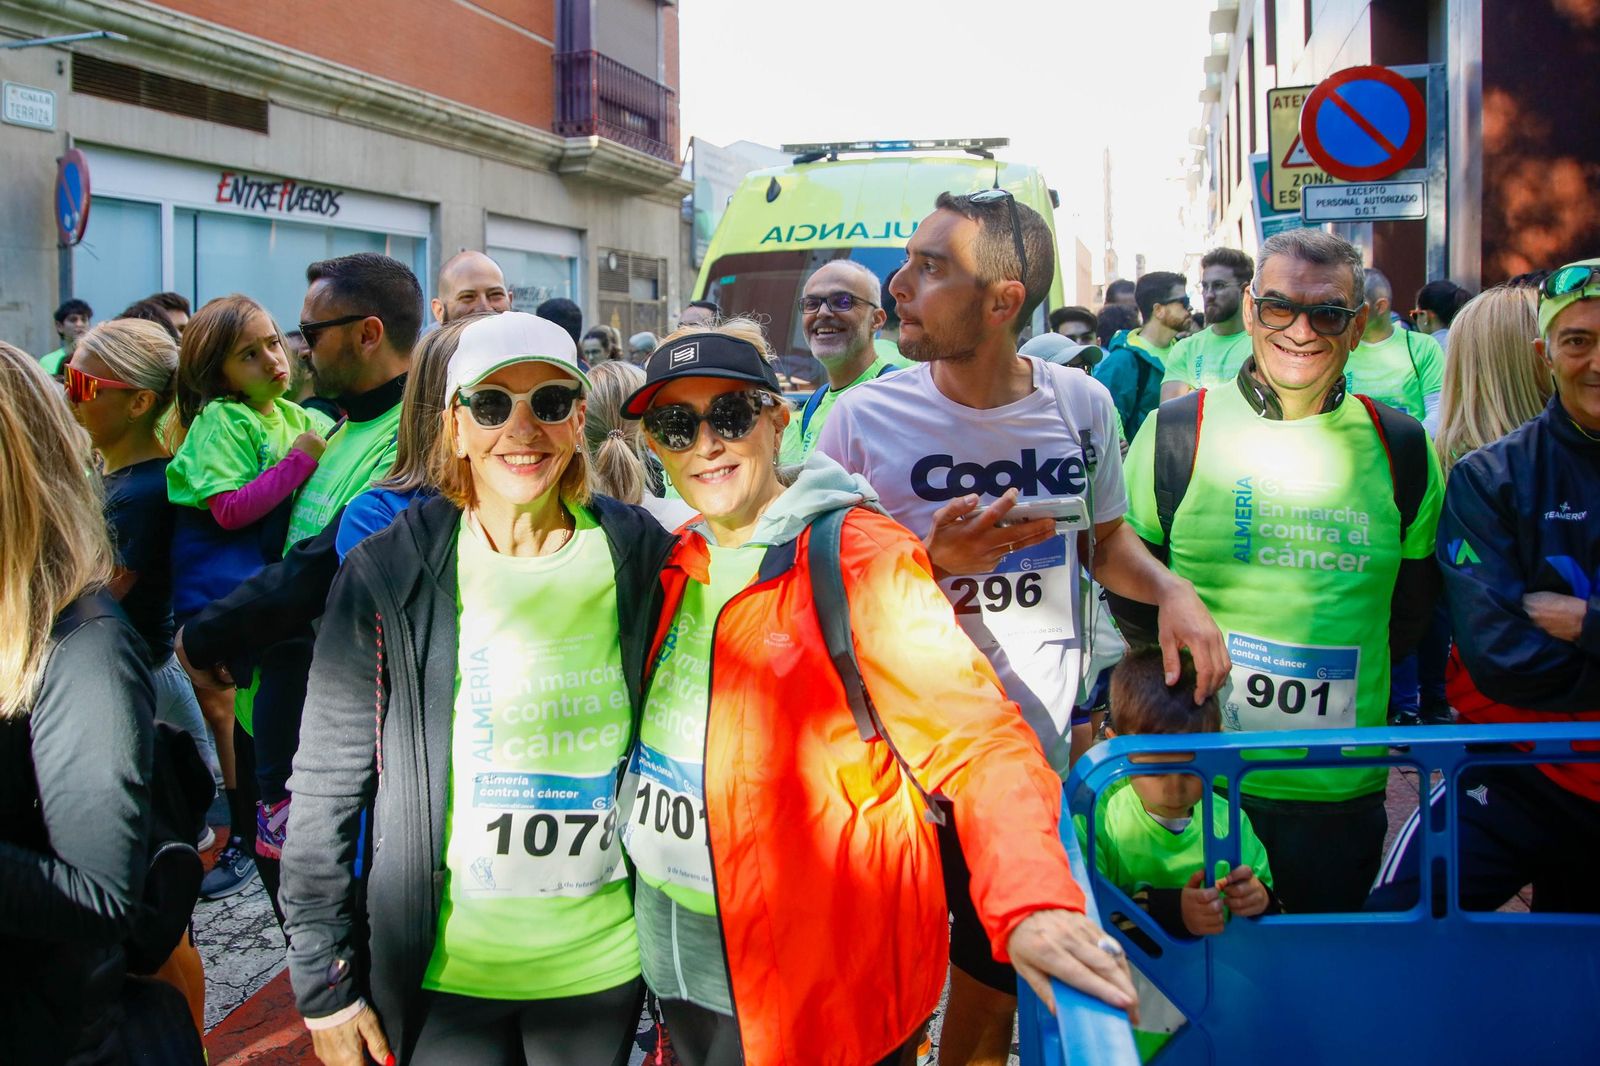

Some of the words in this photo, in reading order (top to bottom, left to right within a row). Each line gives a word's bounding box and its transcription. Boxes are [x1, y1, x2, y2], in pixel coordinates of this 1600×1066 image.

[10, 102, 49, 122] TERRIZA
[1293, 173, 1334, 187] ZONA
[1346, 186, 1386, 197] EXCEPTO
[216, 171, 344, 218] ENTREFUEGOS
[1316, 199, 1360, 208] PERSONAL
[1363, 194, 1418, 204] AUTORIZADO
[910, 448, 1087, 502] Cooke
[1231, 474, 1254, 565] ALMERÍA
[1258, 500, 1285, 518] En
[1291, 505, 1370, 526] marcha
[1258, 522, 1341, 544] contra
[1347, 526, 1371, 547] el
[1257, 541, 1371, 573] cáncer
[950, 571, 1043, 615] 296
[1232, 636, 1268, 653] Almería
[1231, 647, 1261, 662] contra
[1261, 655, 1273, 665] el
[1273, 658, 1308, 670] cáncer
[464, 645, 494, 763] ALMERÍA
[1246, 673, 1331, 717] 901
[502, 692, 602, 726] contra
[501, 720, 631, 762] cáncer
[479, 786, 520, 798] contra
[522, 788, 535, 799] el
[537, 788, 580, 800] cáncer
[481, 774, 529, 786] Almería
